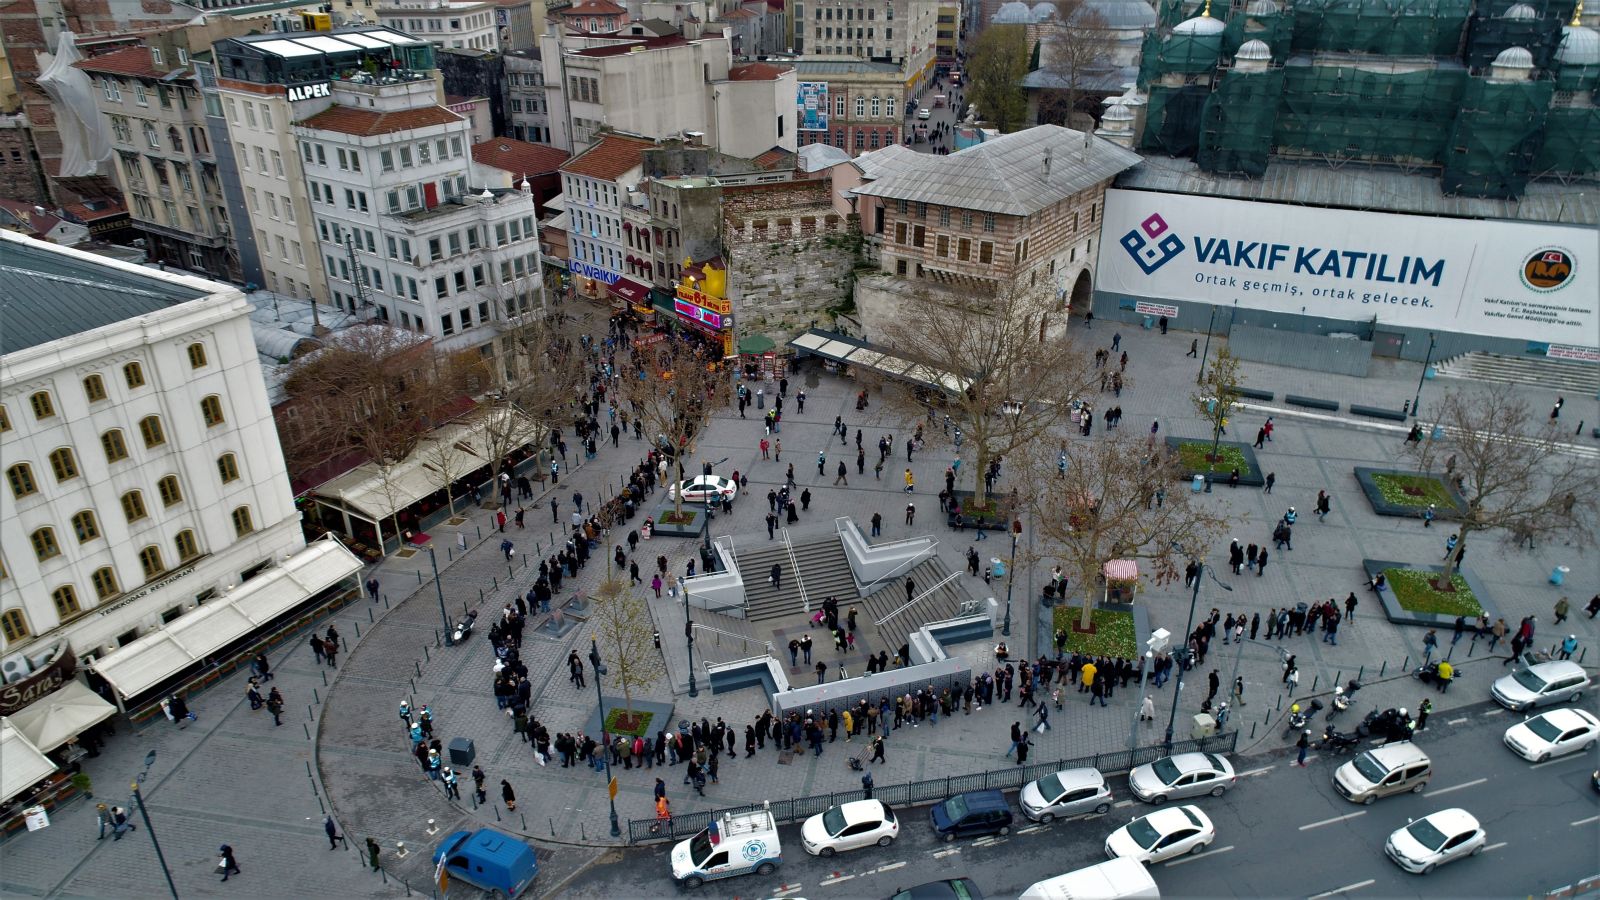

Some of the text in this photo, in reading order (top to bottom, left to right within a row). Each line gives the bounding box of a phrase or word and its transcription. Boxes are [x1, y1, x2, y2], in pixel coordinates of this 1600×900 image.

[288, 83, 331, 102] ALPEK
[569, 259, 582, 274] LC
[1193, 236, 1446, 287] VAKIF KATILIM
[1194, 272, 1434, 309] Ortak geçmiş, ortak gelecek.
[693, 291, 707, 307] 61
[721, 304, 730, 312] 61
[1522, 308, 1558, 317] Başbakanlık
[1528, 302, 1567, 311] sermayesinin
[1568, 306, 1592, 314] tamamı
[1566, 319, 1583, 327] aittir.
[149, 566, 196, 593] RESTAURANT
